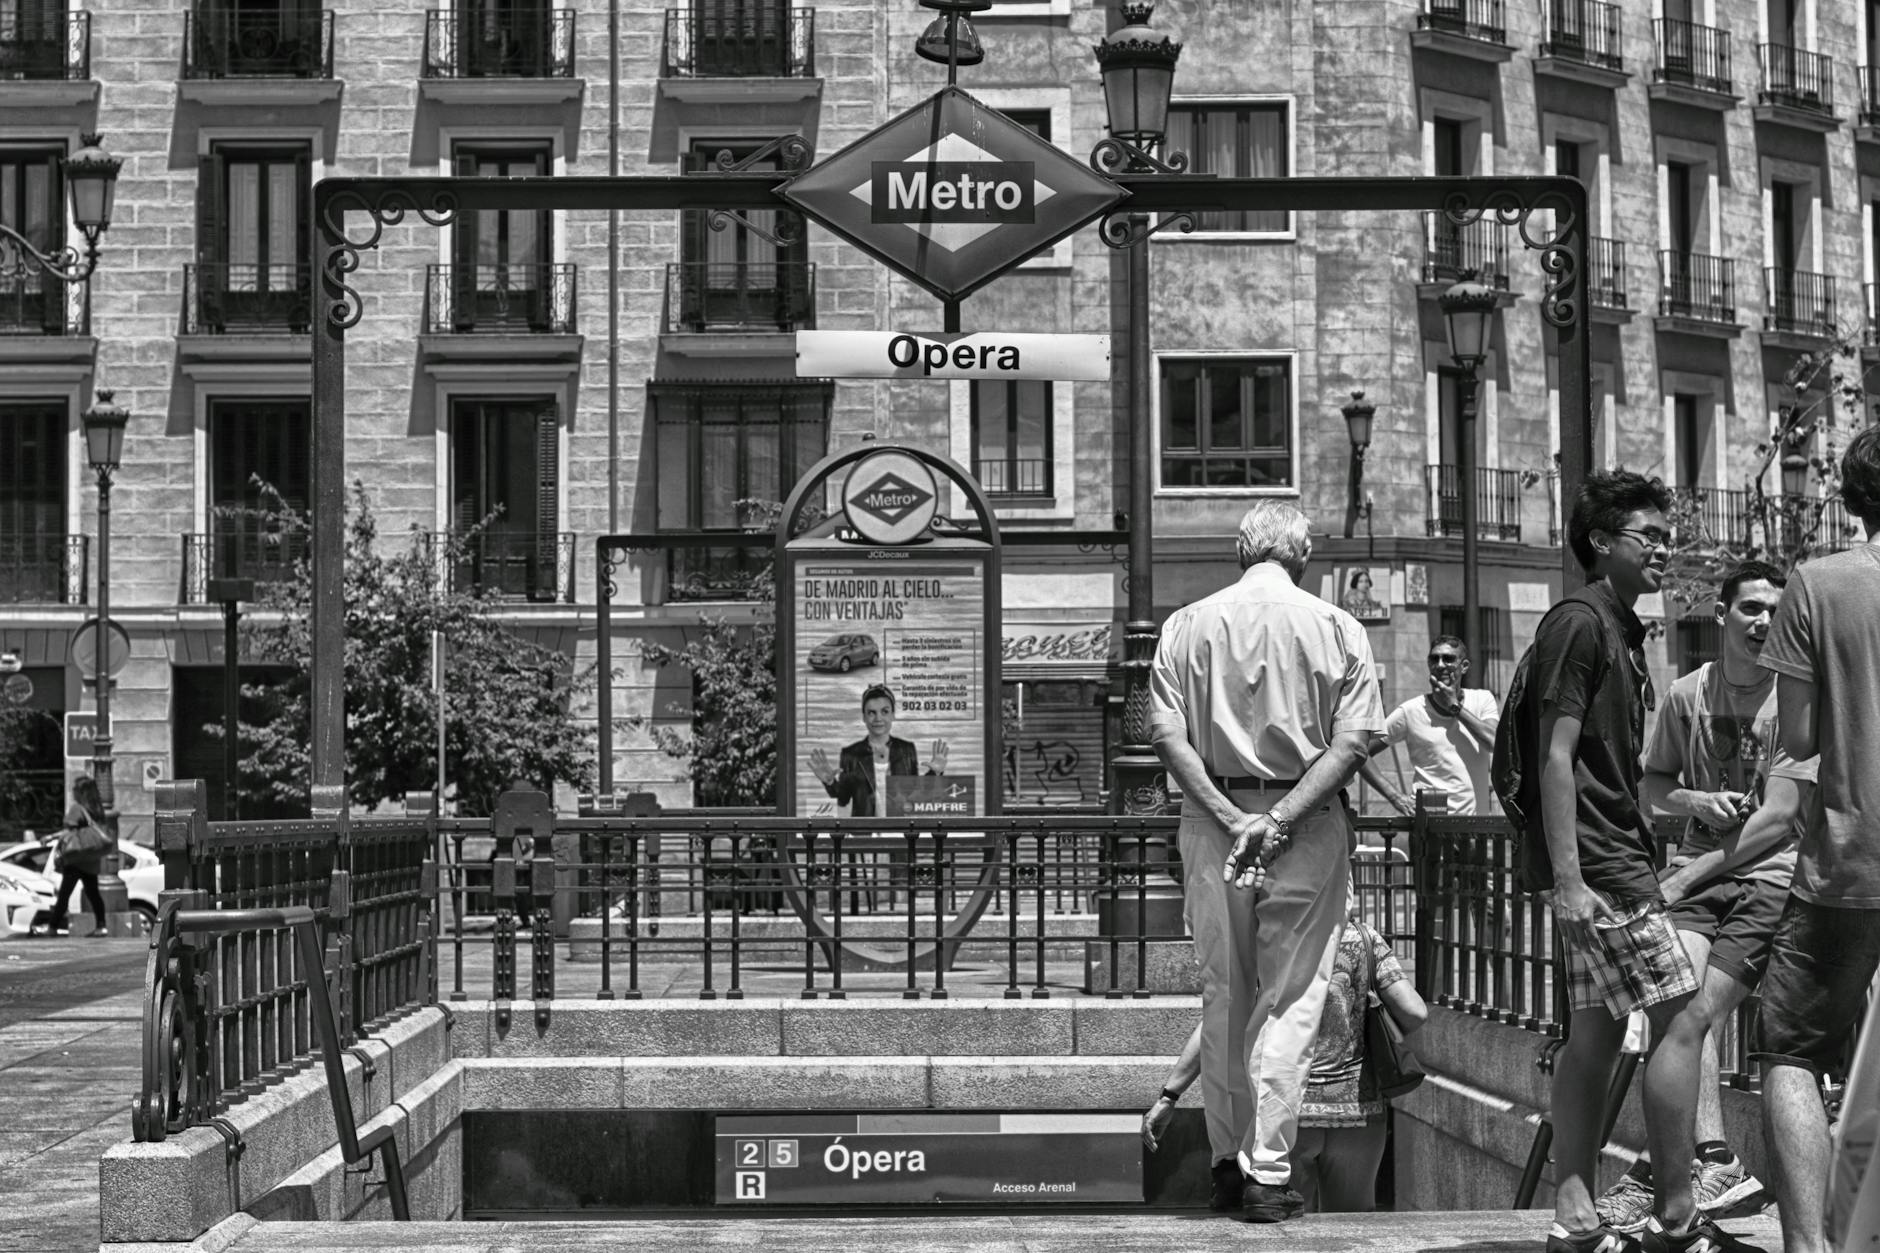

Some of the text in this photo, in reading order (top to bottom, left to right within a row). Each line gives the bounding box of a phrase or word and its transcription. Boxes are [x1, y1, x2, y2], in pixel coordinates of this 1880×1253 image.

[888, 172, 1022, 210] Metro
[887, 335, 1020, 376] Opera
[870, 492, 912, 507] Metro
[805, 580, 954, 598] DE MADRID AL CIELO...
[805, 601, 831, 620] CON
[902, 701, 967, 711] 902 03 02 03
[914, 802, 967, 812] MAPFRE
[743, 1136, 926, 1179] 2 5 Ópera
[742, 1174, 761, 1197] R
[992, 1181, 1076, 1193] Acceso Arenal
